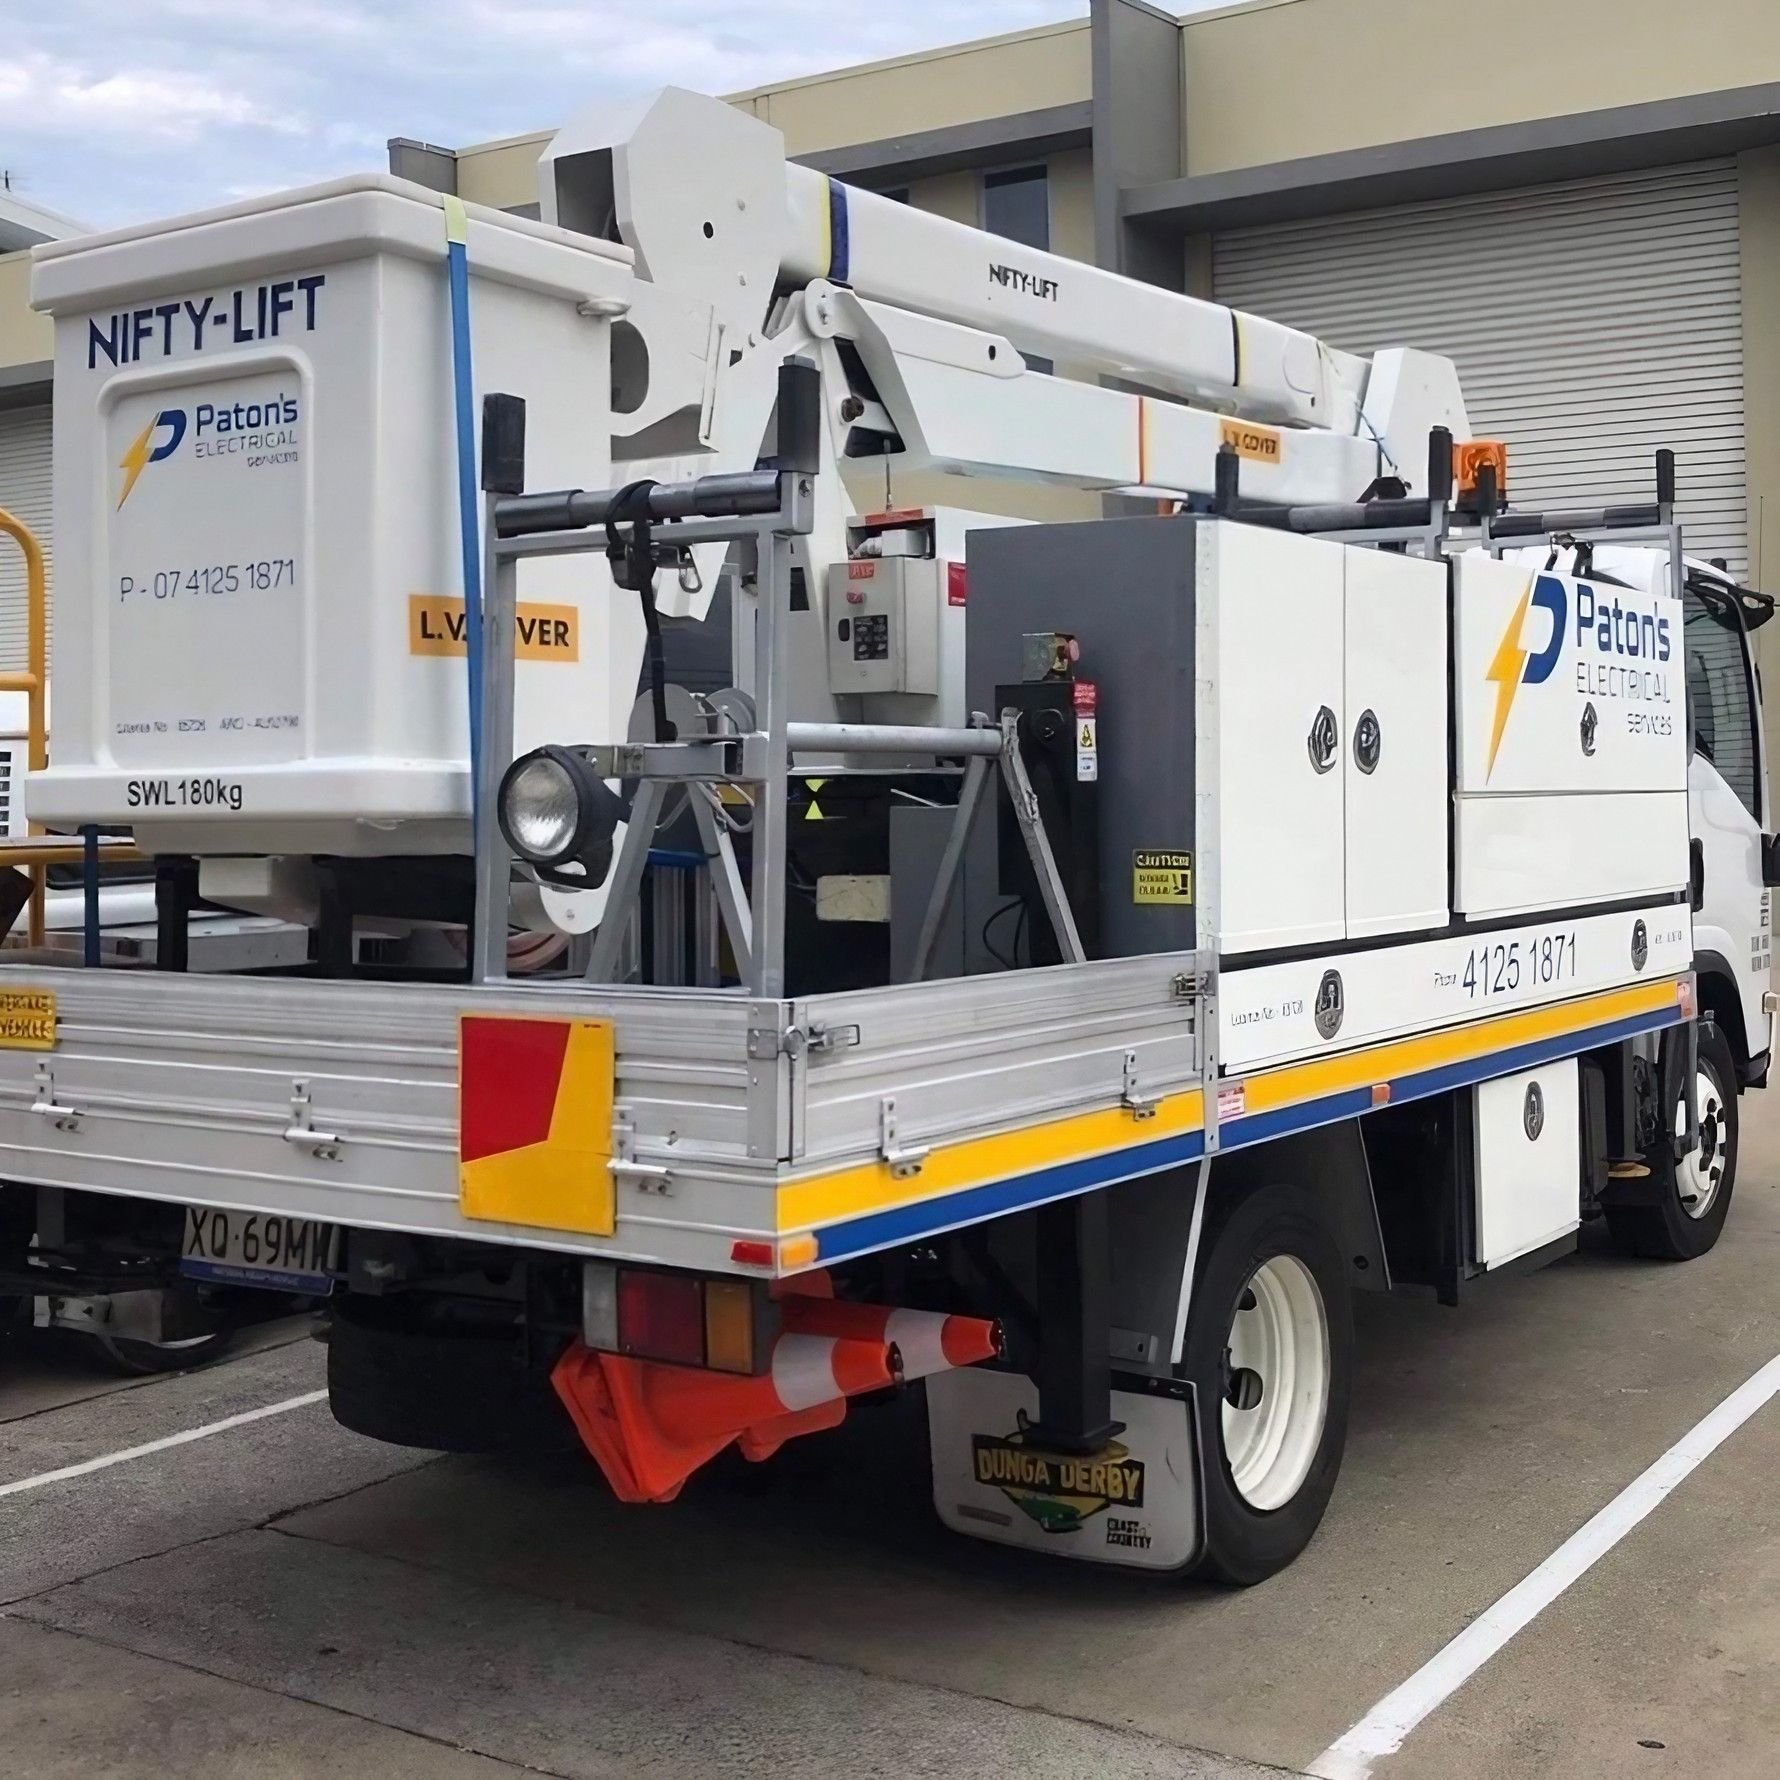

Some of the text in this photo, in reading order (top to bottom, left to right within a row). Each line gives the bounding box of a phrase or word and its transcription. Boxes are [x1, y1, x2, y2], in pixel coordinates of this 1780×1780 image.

[88, 275, 326, 369] NIFTY-LIFT
[195, 393, 299, 436] Paton's
[195, 430, 298, 458] ELECTRICAL
[121, 576, 135, 603] P
[154, 571, 181, 600] 07
[185, 565, 239, 595] 4125
[245, 558, 295, 590] 1871
[1576, 583, 1671, 662] Paton's
[1576, 662, 1671, 704] ELECTRICAL
[1463, 931, 1577, 998] 4125 1871
[976, 1447, 1050, 1486] DUNGA
